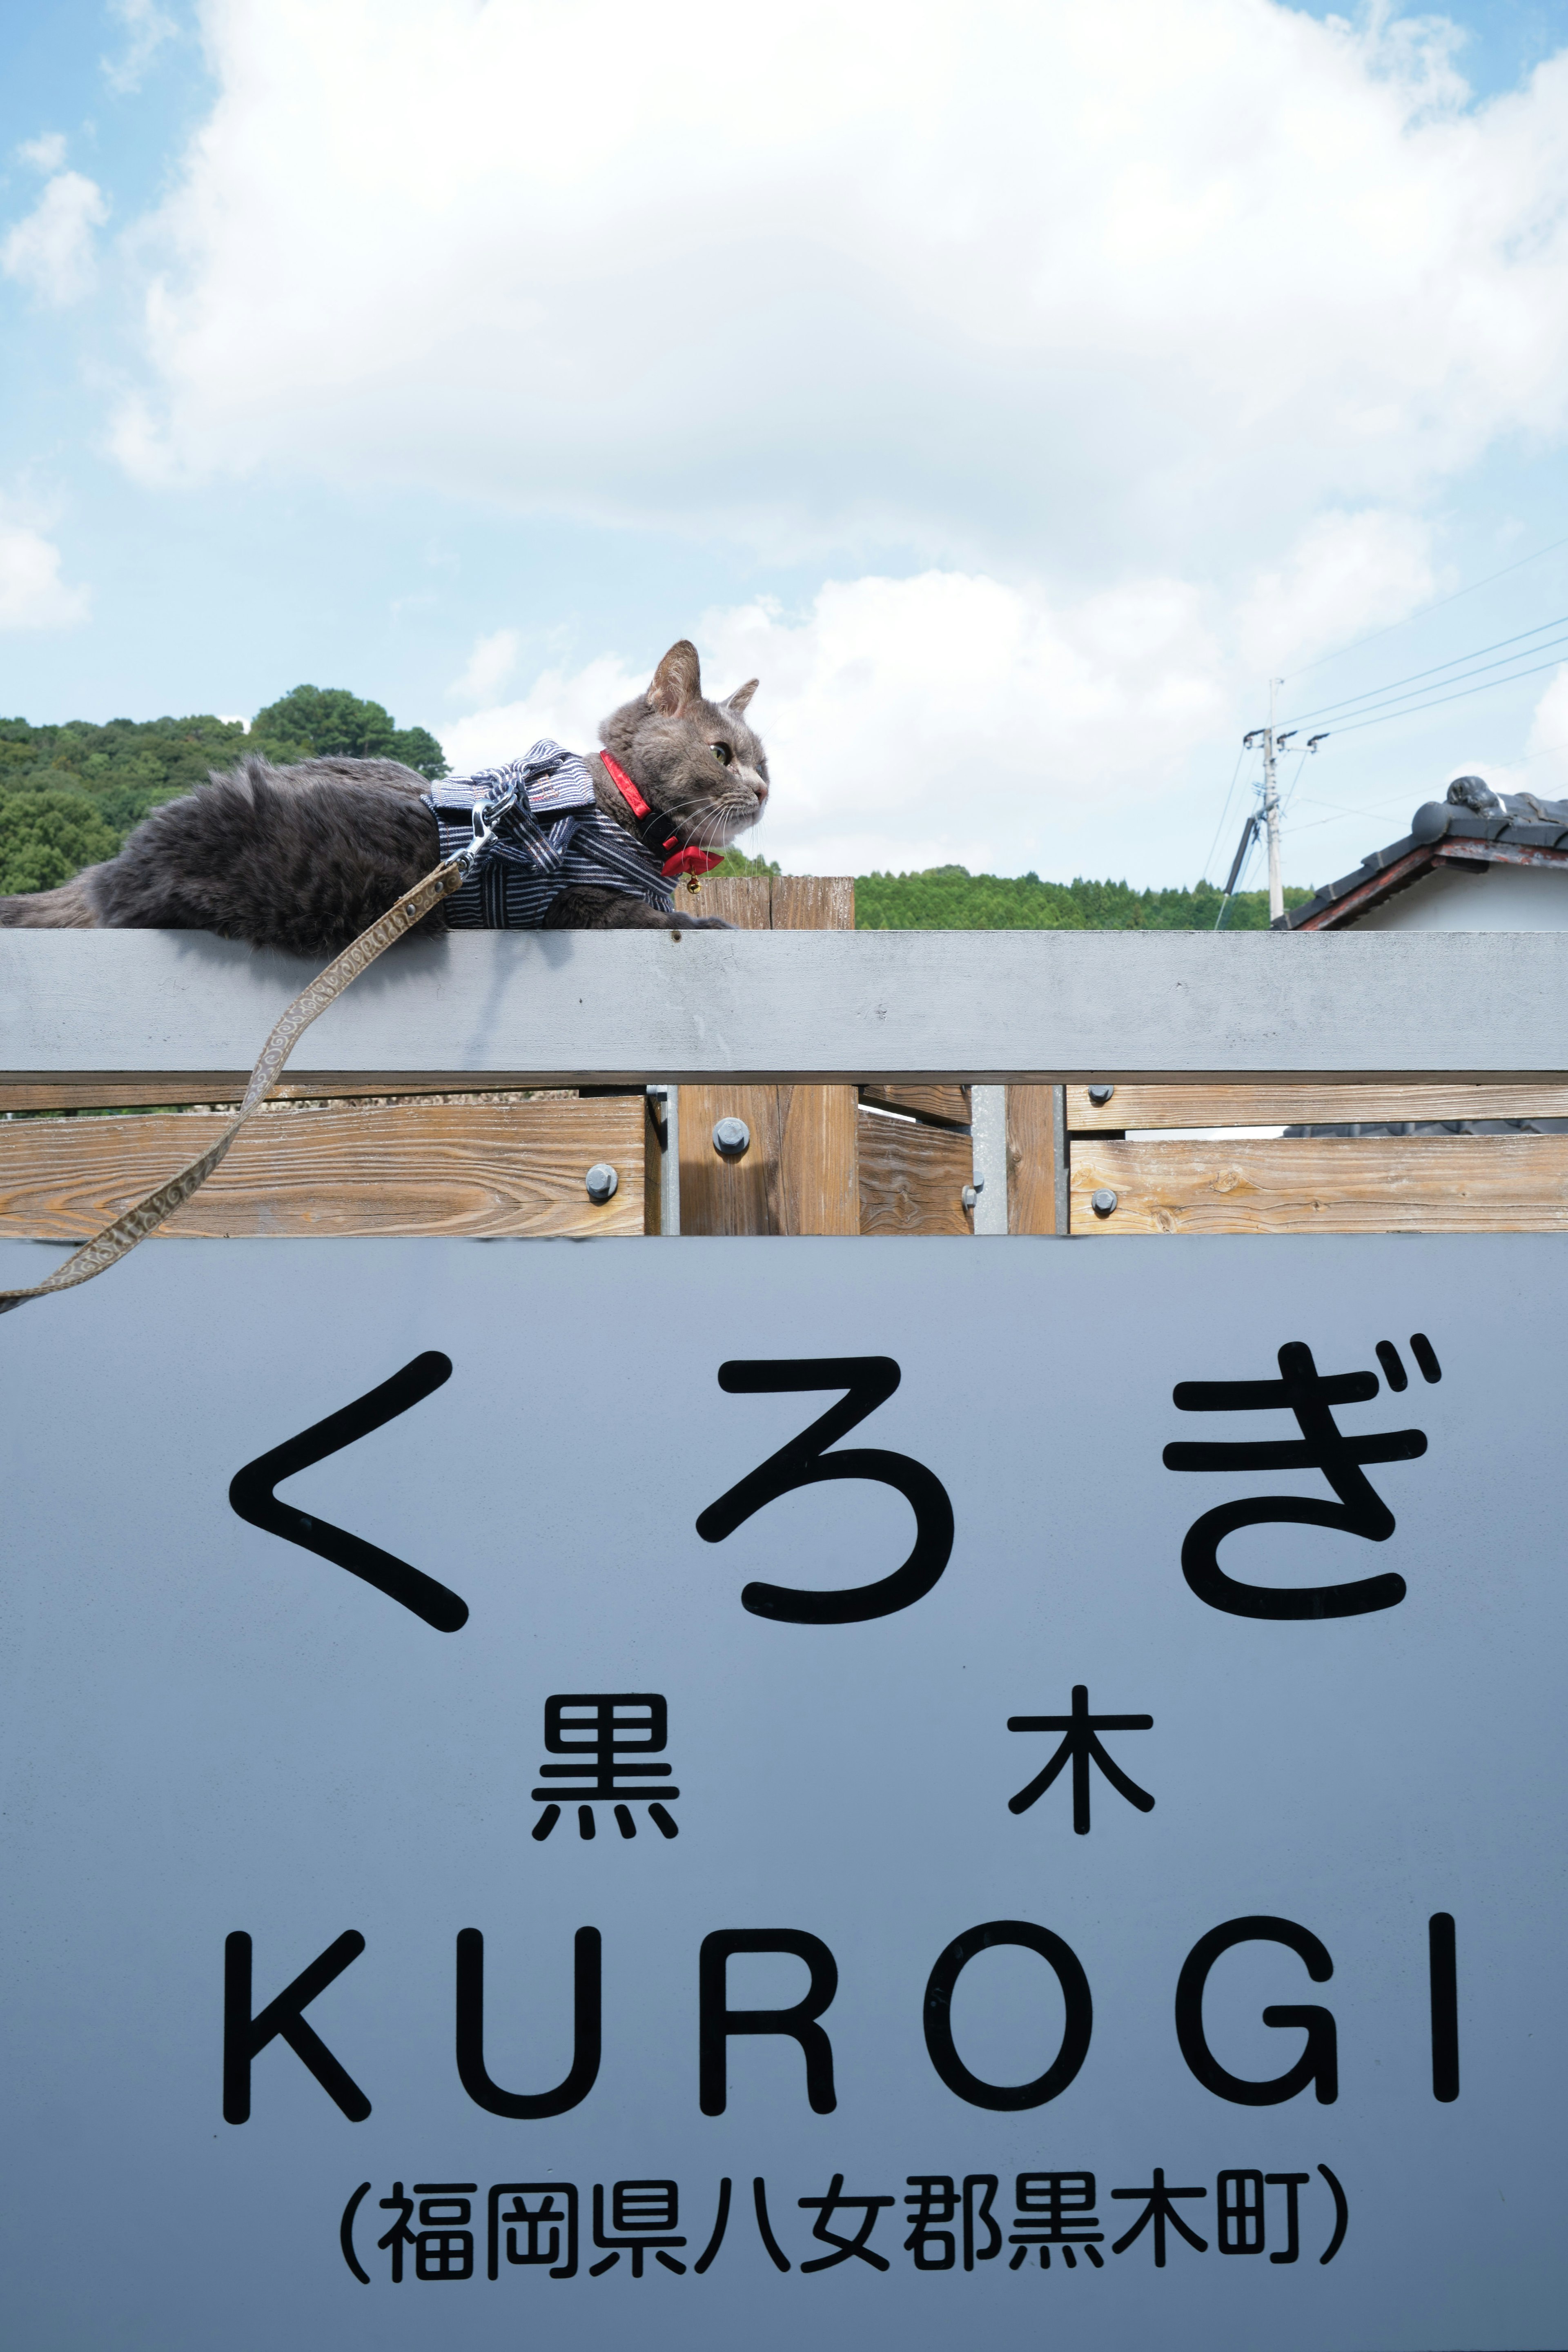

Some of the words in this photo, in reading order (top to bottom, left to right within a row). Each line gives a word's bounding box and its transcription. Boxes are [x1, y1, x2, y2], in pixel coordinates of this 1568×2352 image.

[229, 1333, 1442, 1633] くろぎ
[531, 1685, 1156, 1842] 黒木
[223, 1912, 1460, 2125] KUROGI
[340, 2163, 1349, 2285] (福岡県八女郡黒木町)
